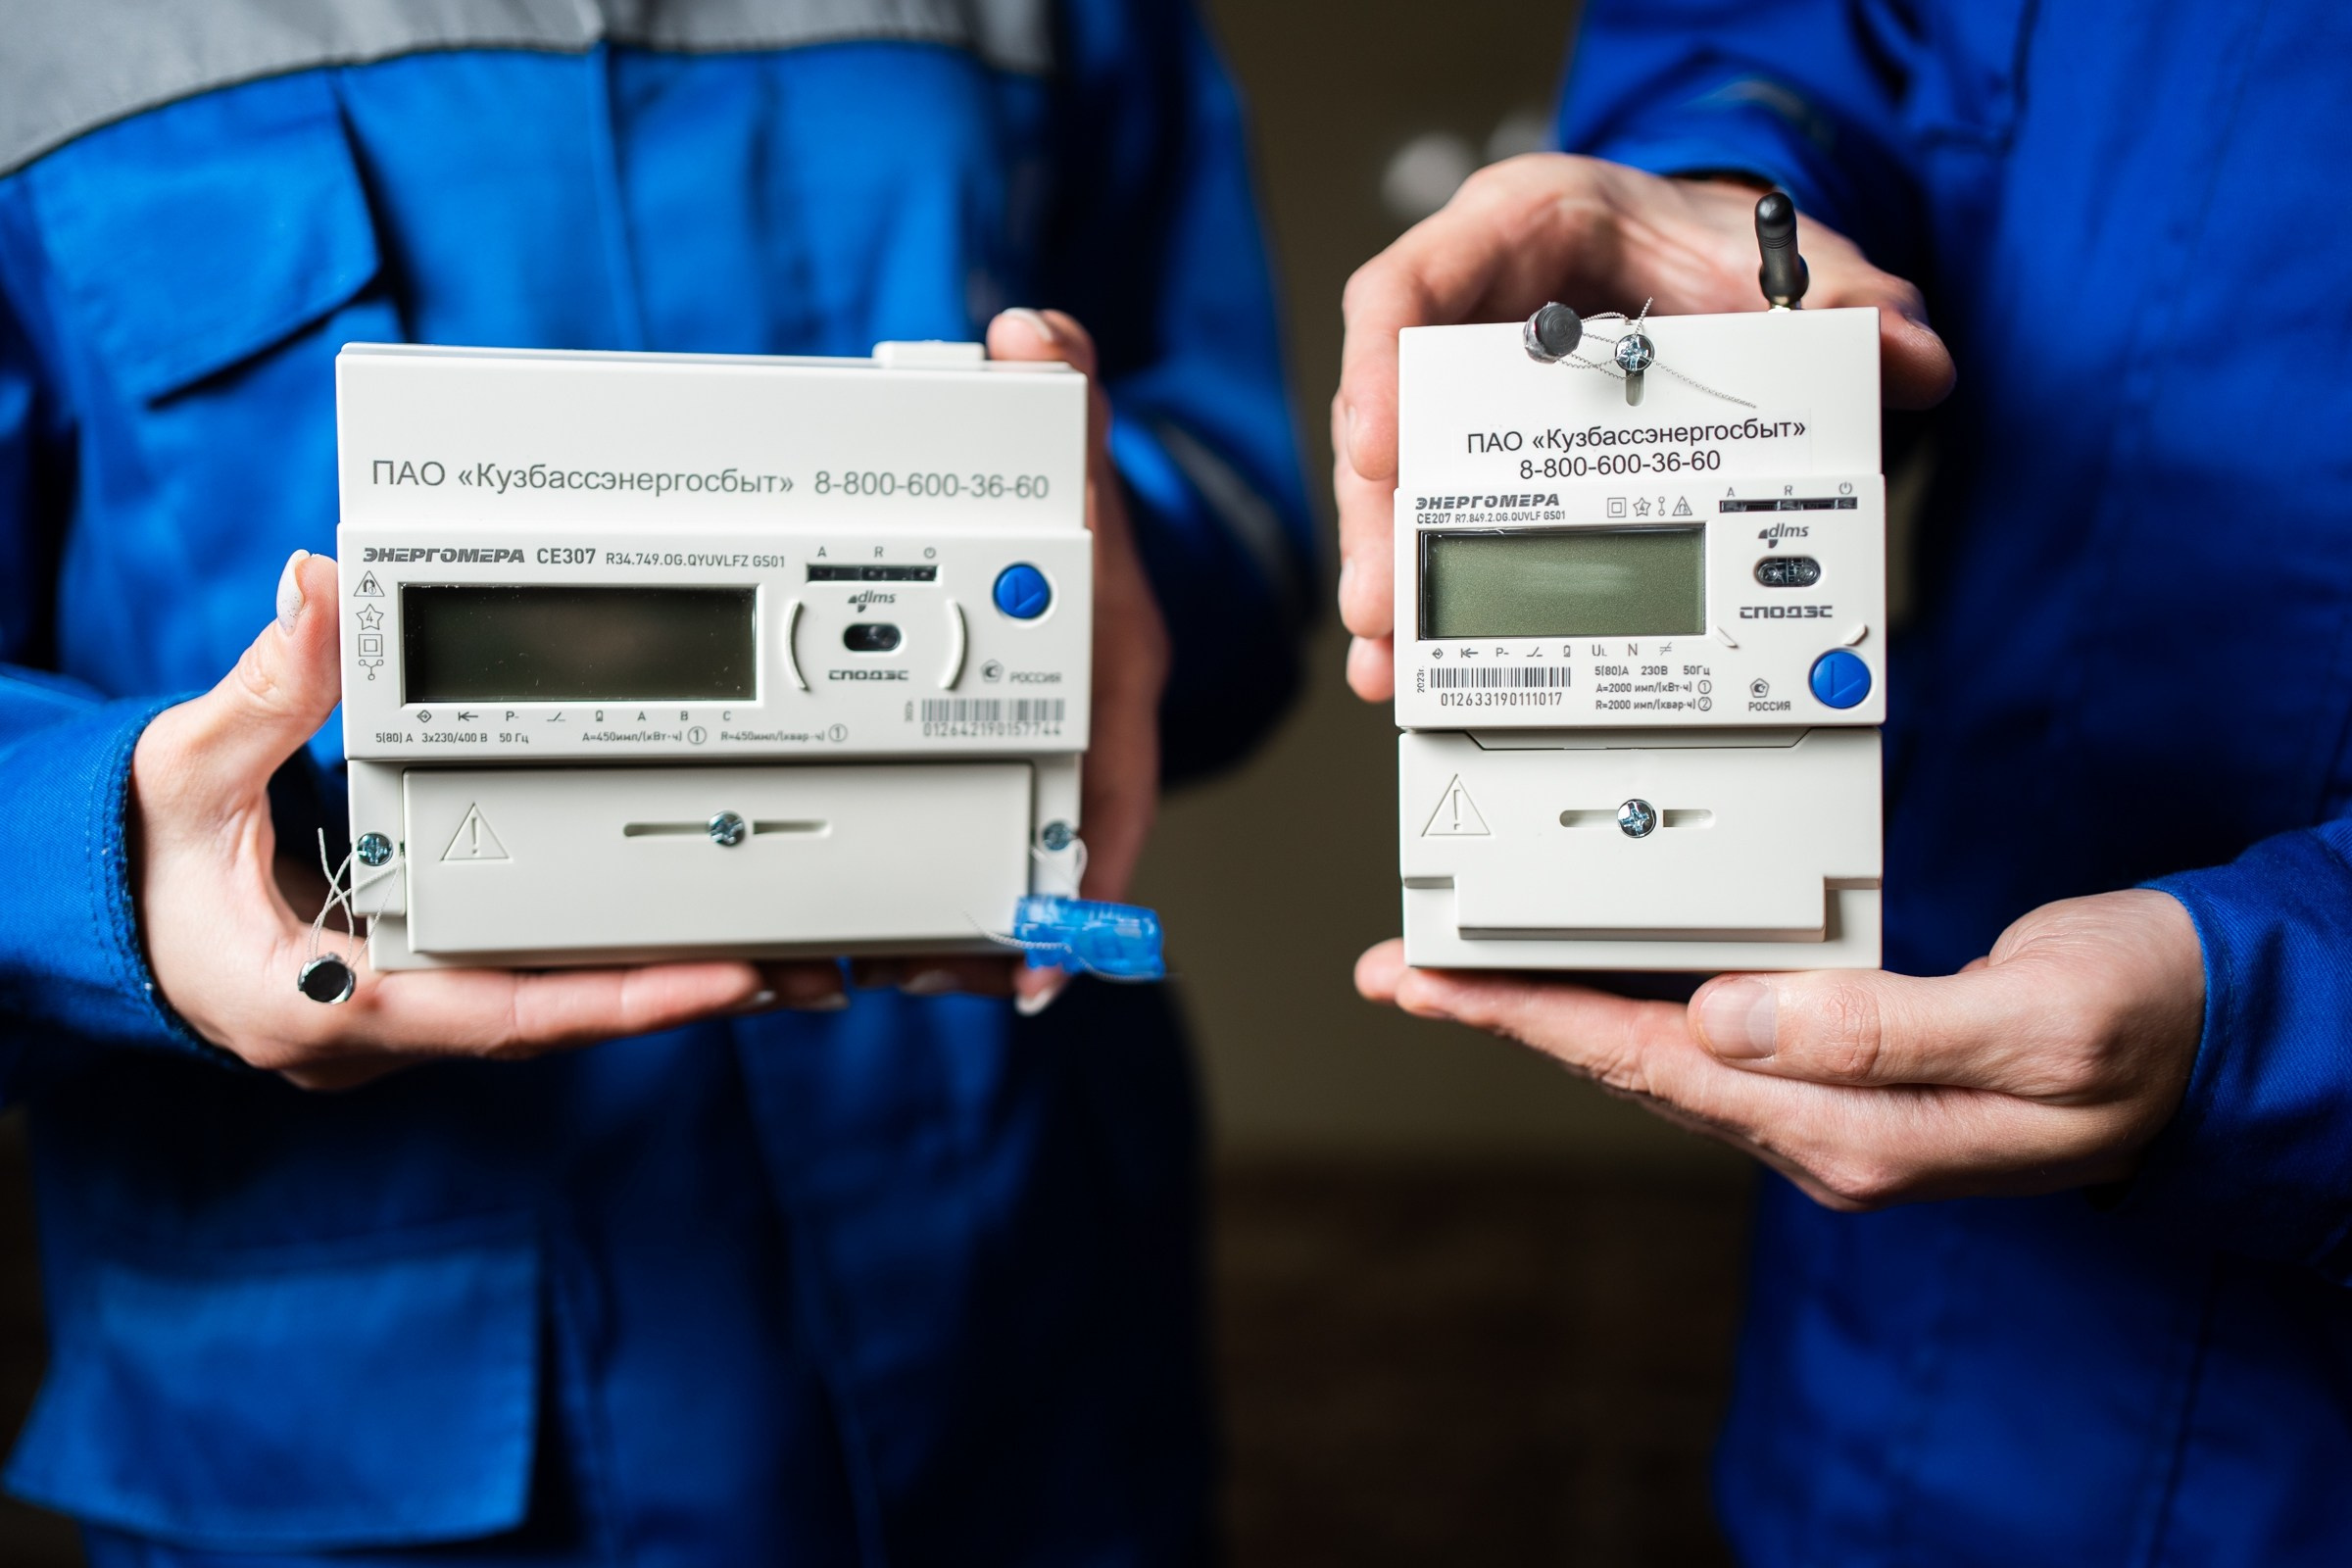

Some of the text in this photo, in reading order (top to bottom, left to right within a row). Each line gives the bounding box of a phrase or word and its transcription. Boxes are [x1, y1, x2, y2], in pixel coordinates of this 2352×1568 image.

[1467, 417, 1806, 454] ПАО «Кузбассэнергосбыт»
[1519, 450, 1721, 480] 8-800-600-36-60
[372, 460, 1050, 499] ПАО «Кузбассэнергосбыт» 8-800-600-36-60
[1727, 486, 1735, 497] A
[1784, 485, 1792, 496] R
[1415, 493, 1560, 511] ЭНЕРГОМЕРА
[1416, 513, 1451, 524] CE207
[1769, 522, 1809, 538] dlms
[363, 547, 525, 564] ЭНЕРГОМЕРА
[536, 548, 597, 565] CE307
[817, 546, 827, 558] A
[874, 546, 883, 558] R
[858, 590, 897, 605] dlms
[1739, 605, 1834, 619] СПОДЭС
[1627, 643, 1639, 657] N
[1441, 692, 1563, 707] 012633190111017
[1595, 700, 1632, 710] R=2000
[1748, 701, 1791, 711] РОССИЯ
[637, 710, 647, 722] A
[375, 732, 403, 744] 5(80)
[499, 733, 513, 744] 50
[514, 733, 530, 745] Гц
